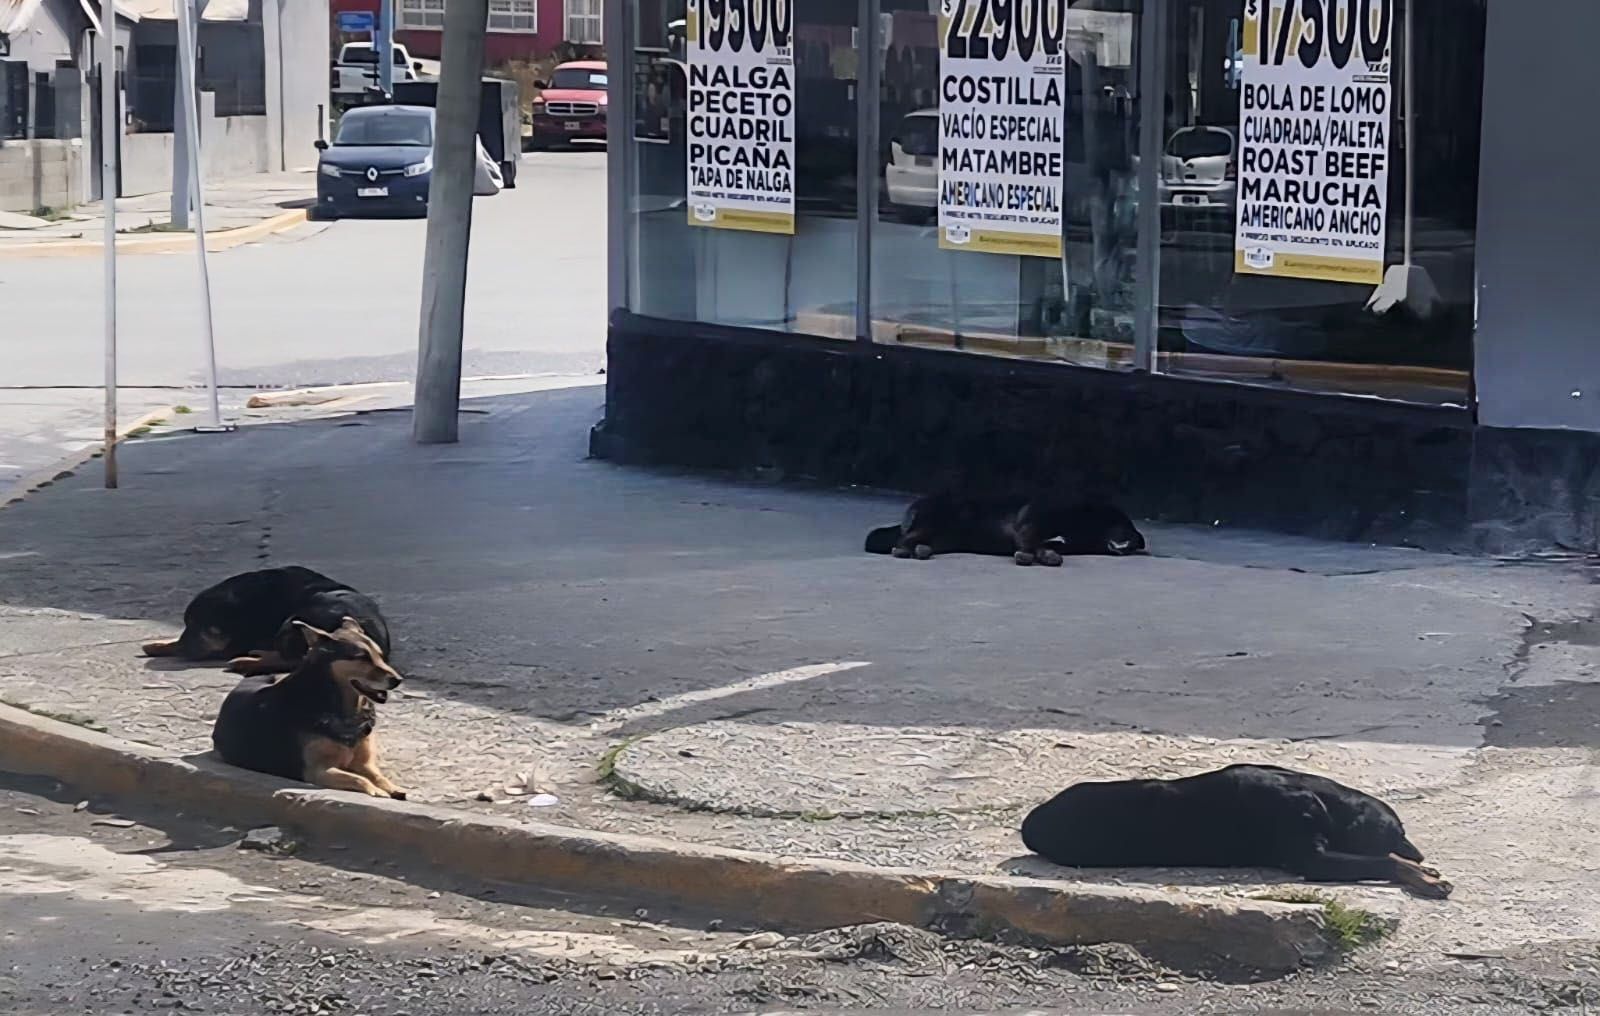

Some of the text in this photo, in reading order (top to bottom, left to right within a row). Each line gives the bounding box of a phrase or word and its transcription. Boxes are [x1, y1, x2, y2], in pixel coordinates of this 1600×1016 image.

[690, 64, 791, 90] NALGA
[943, 75, 1061, 106] COSTILLA
[690, 90, 792, 117] PECETO
[1244, 84, 1386, 115] BOLA DE LOMO
[690, 116, 792, 143] CUADRIL
[942, 107, 1061, 143] VACÍO ESPECIAL
[1244, 115, 1384, 151] CUADRADA/PALETA
[690, 143, 791, 170] PICAÑA
[942, 147, 1061, 177] MATAMBRE
[1243, 147, 1385, 179] ROAST BEEF
[690, 166, 792, 192] TAPA DE NALGA
[1241, 177, 1382, 209] MARUCHA
[941, 180, 1059, 212] AMERICANO ESPECIAL
[1240, 203, 1381, 236] AMERICANO ANCHO
